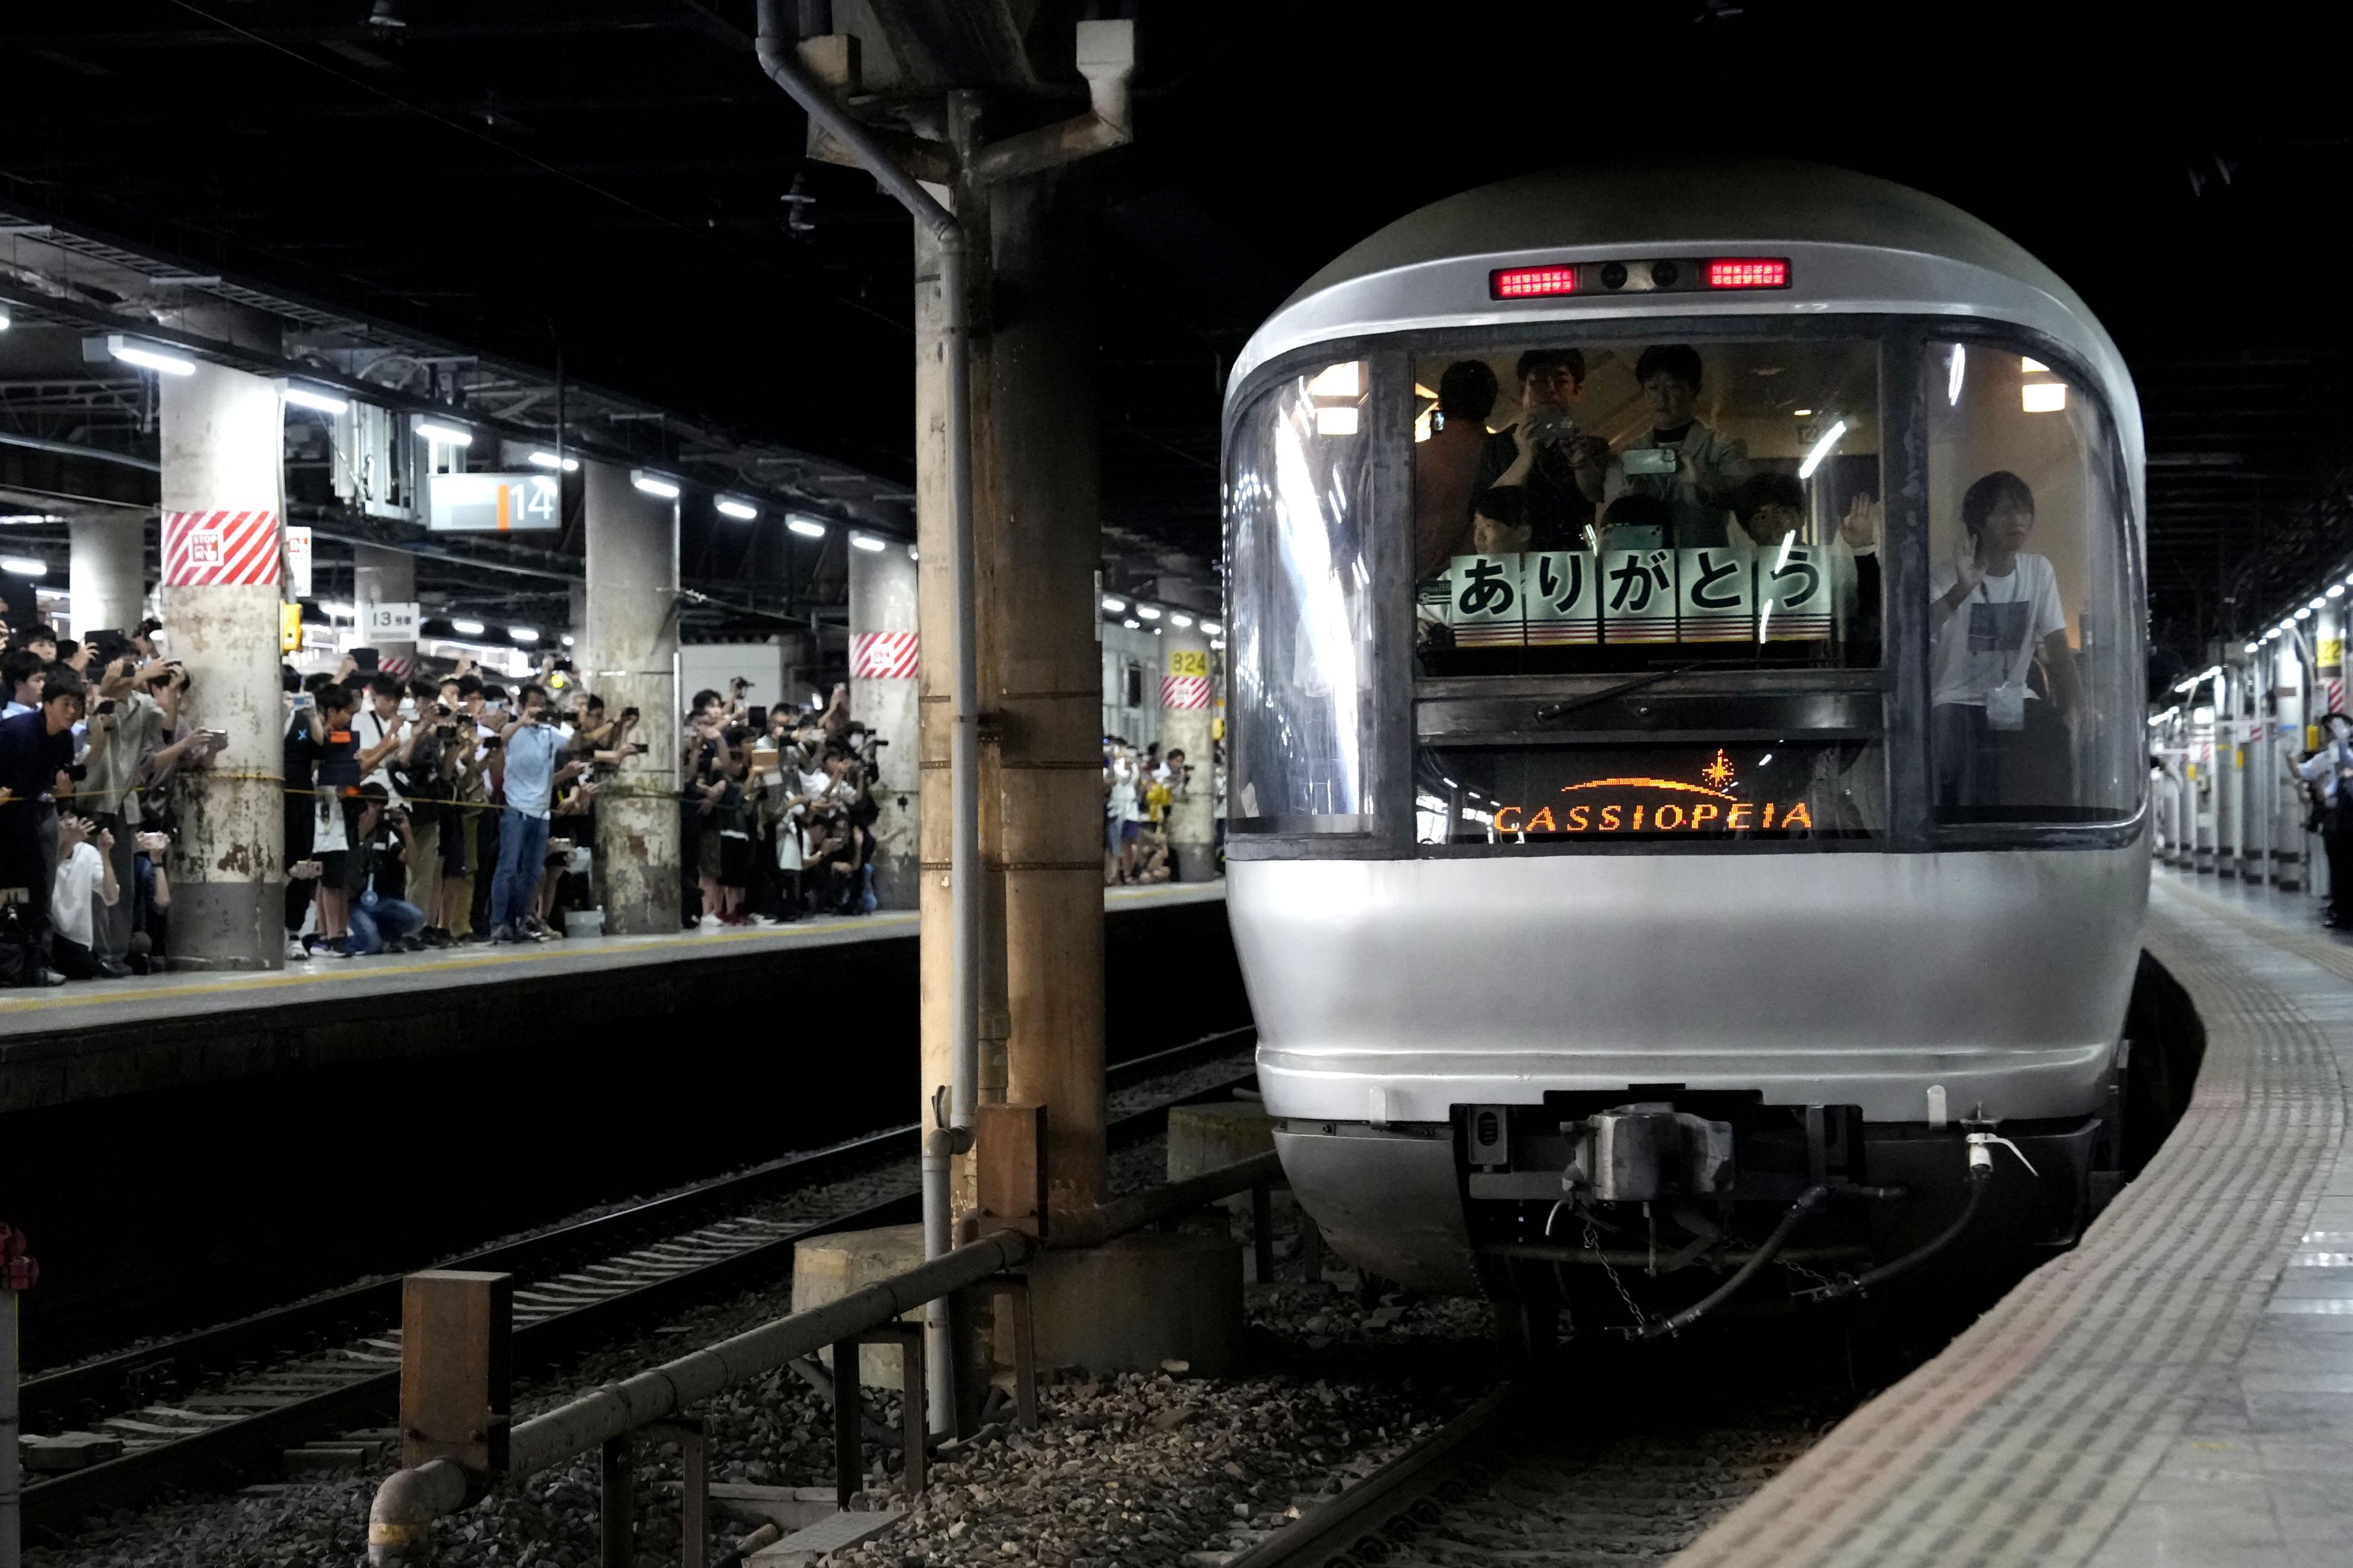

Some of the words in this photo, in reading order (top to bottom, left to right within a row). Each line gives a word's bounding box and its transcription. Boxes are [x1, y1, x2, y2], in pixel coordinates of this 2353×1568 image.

[509, 483, 554, 520] 14
[1459, 551, 1820, 615] ありがとう
[1494, 803, 1812, 832] CASSIOPEIA
